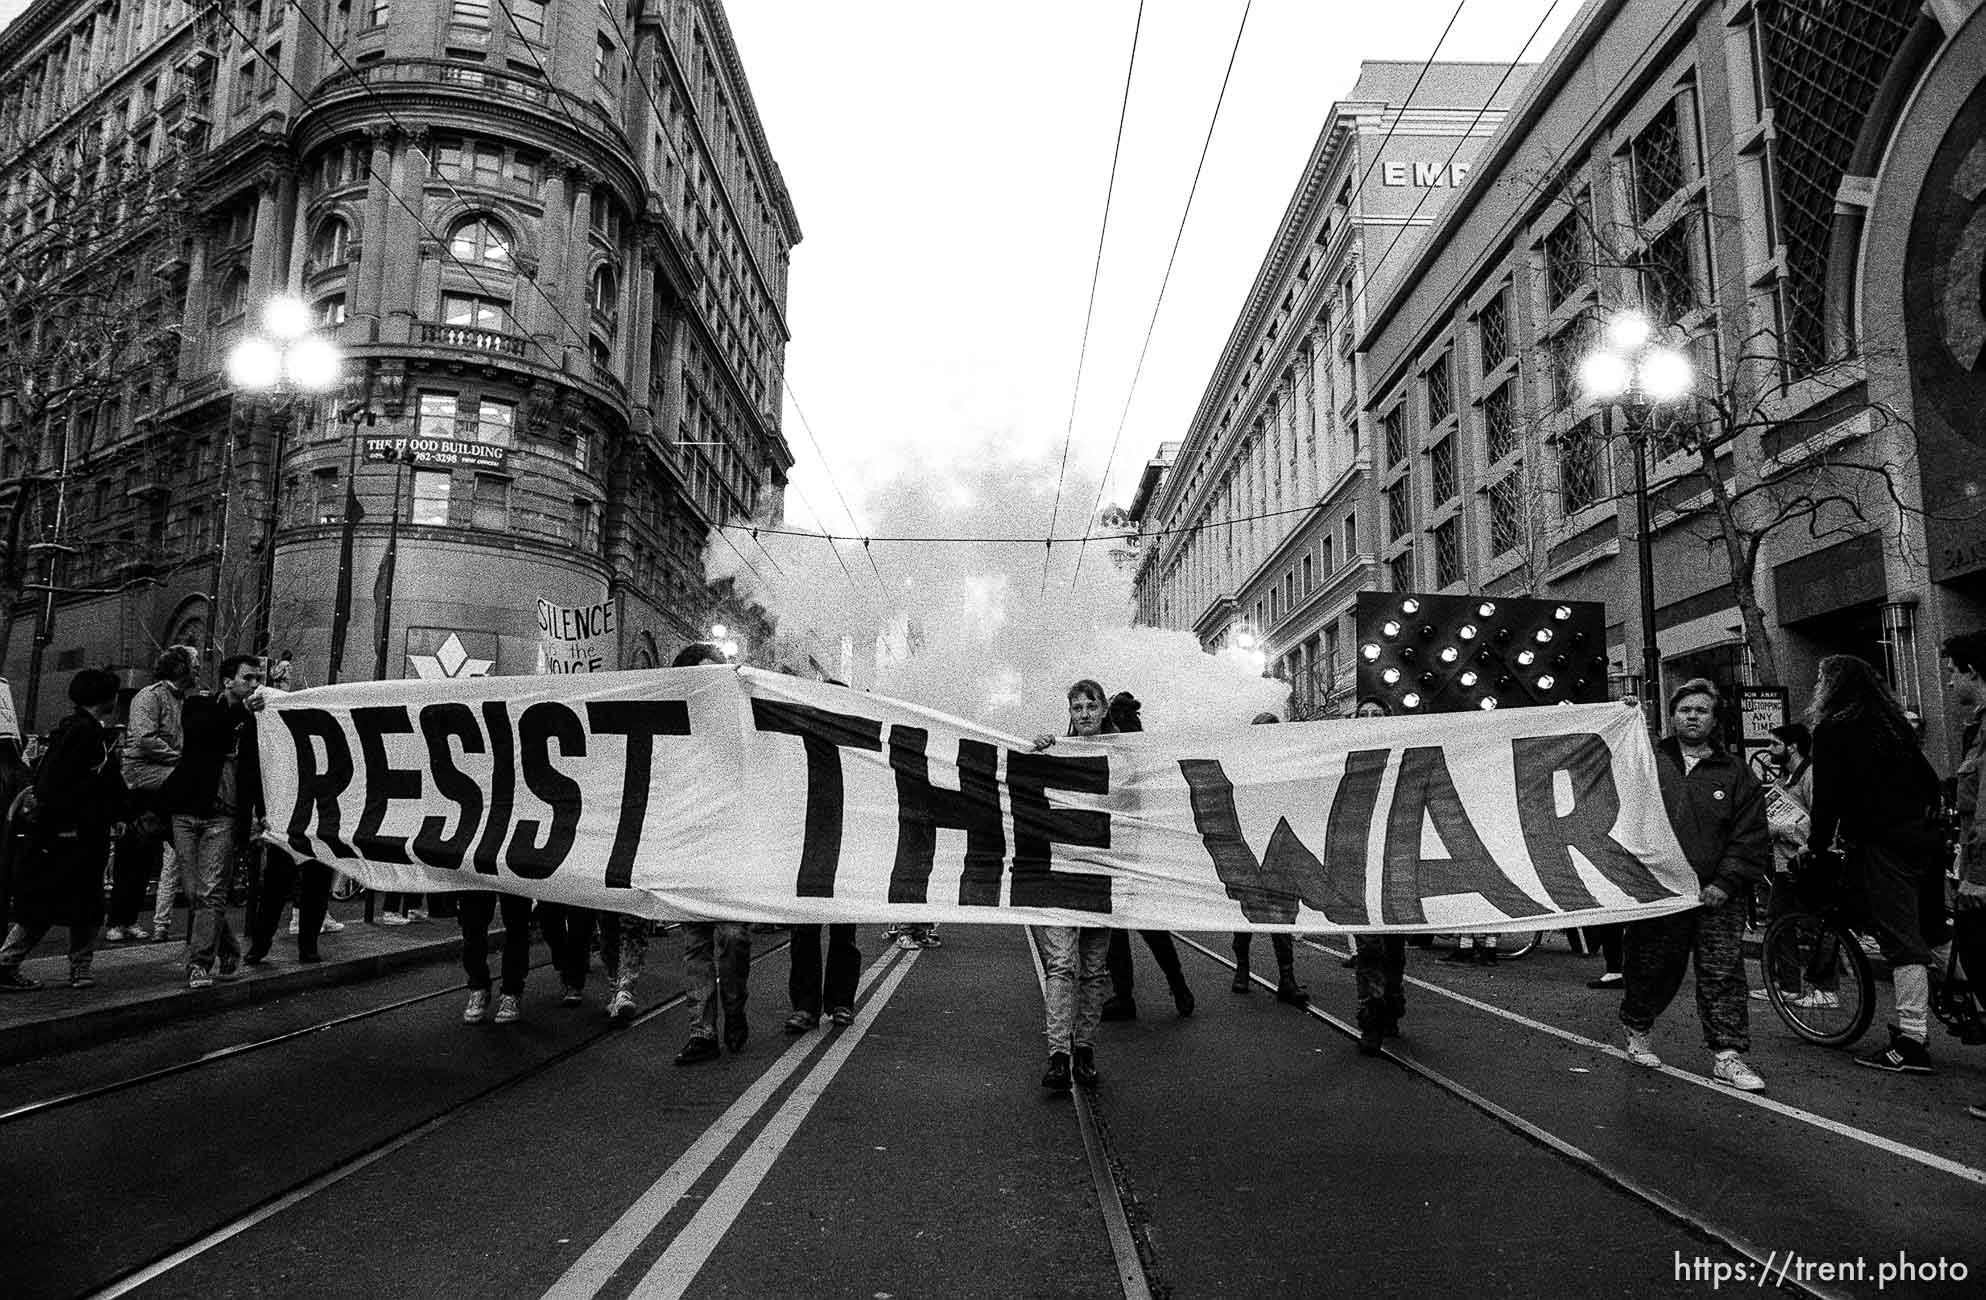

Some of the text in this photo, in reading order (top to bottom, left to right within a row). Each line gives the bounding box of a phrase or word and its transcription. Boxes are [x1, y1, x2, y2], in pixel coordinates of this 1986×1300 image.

[441, 441, 503, 459] BUILDING
[537, 599, 614, 641] SILENCE
[571, 641, 597, 659] the
[1741, 698, 1753, 710] NO
[1752, 712, 1773, 721] ANY
[278, 697, 1682, 924] RESIST THE WAR
